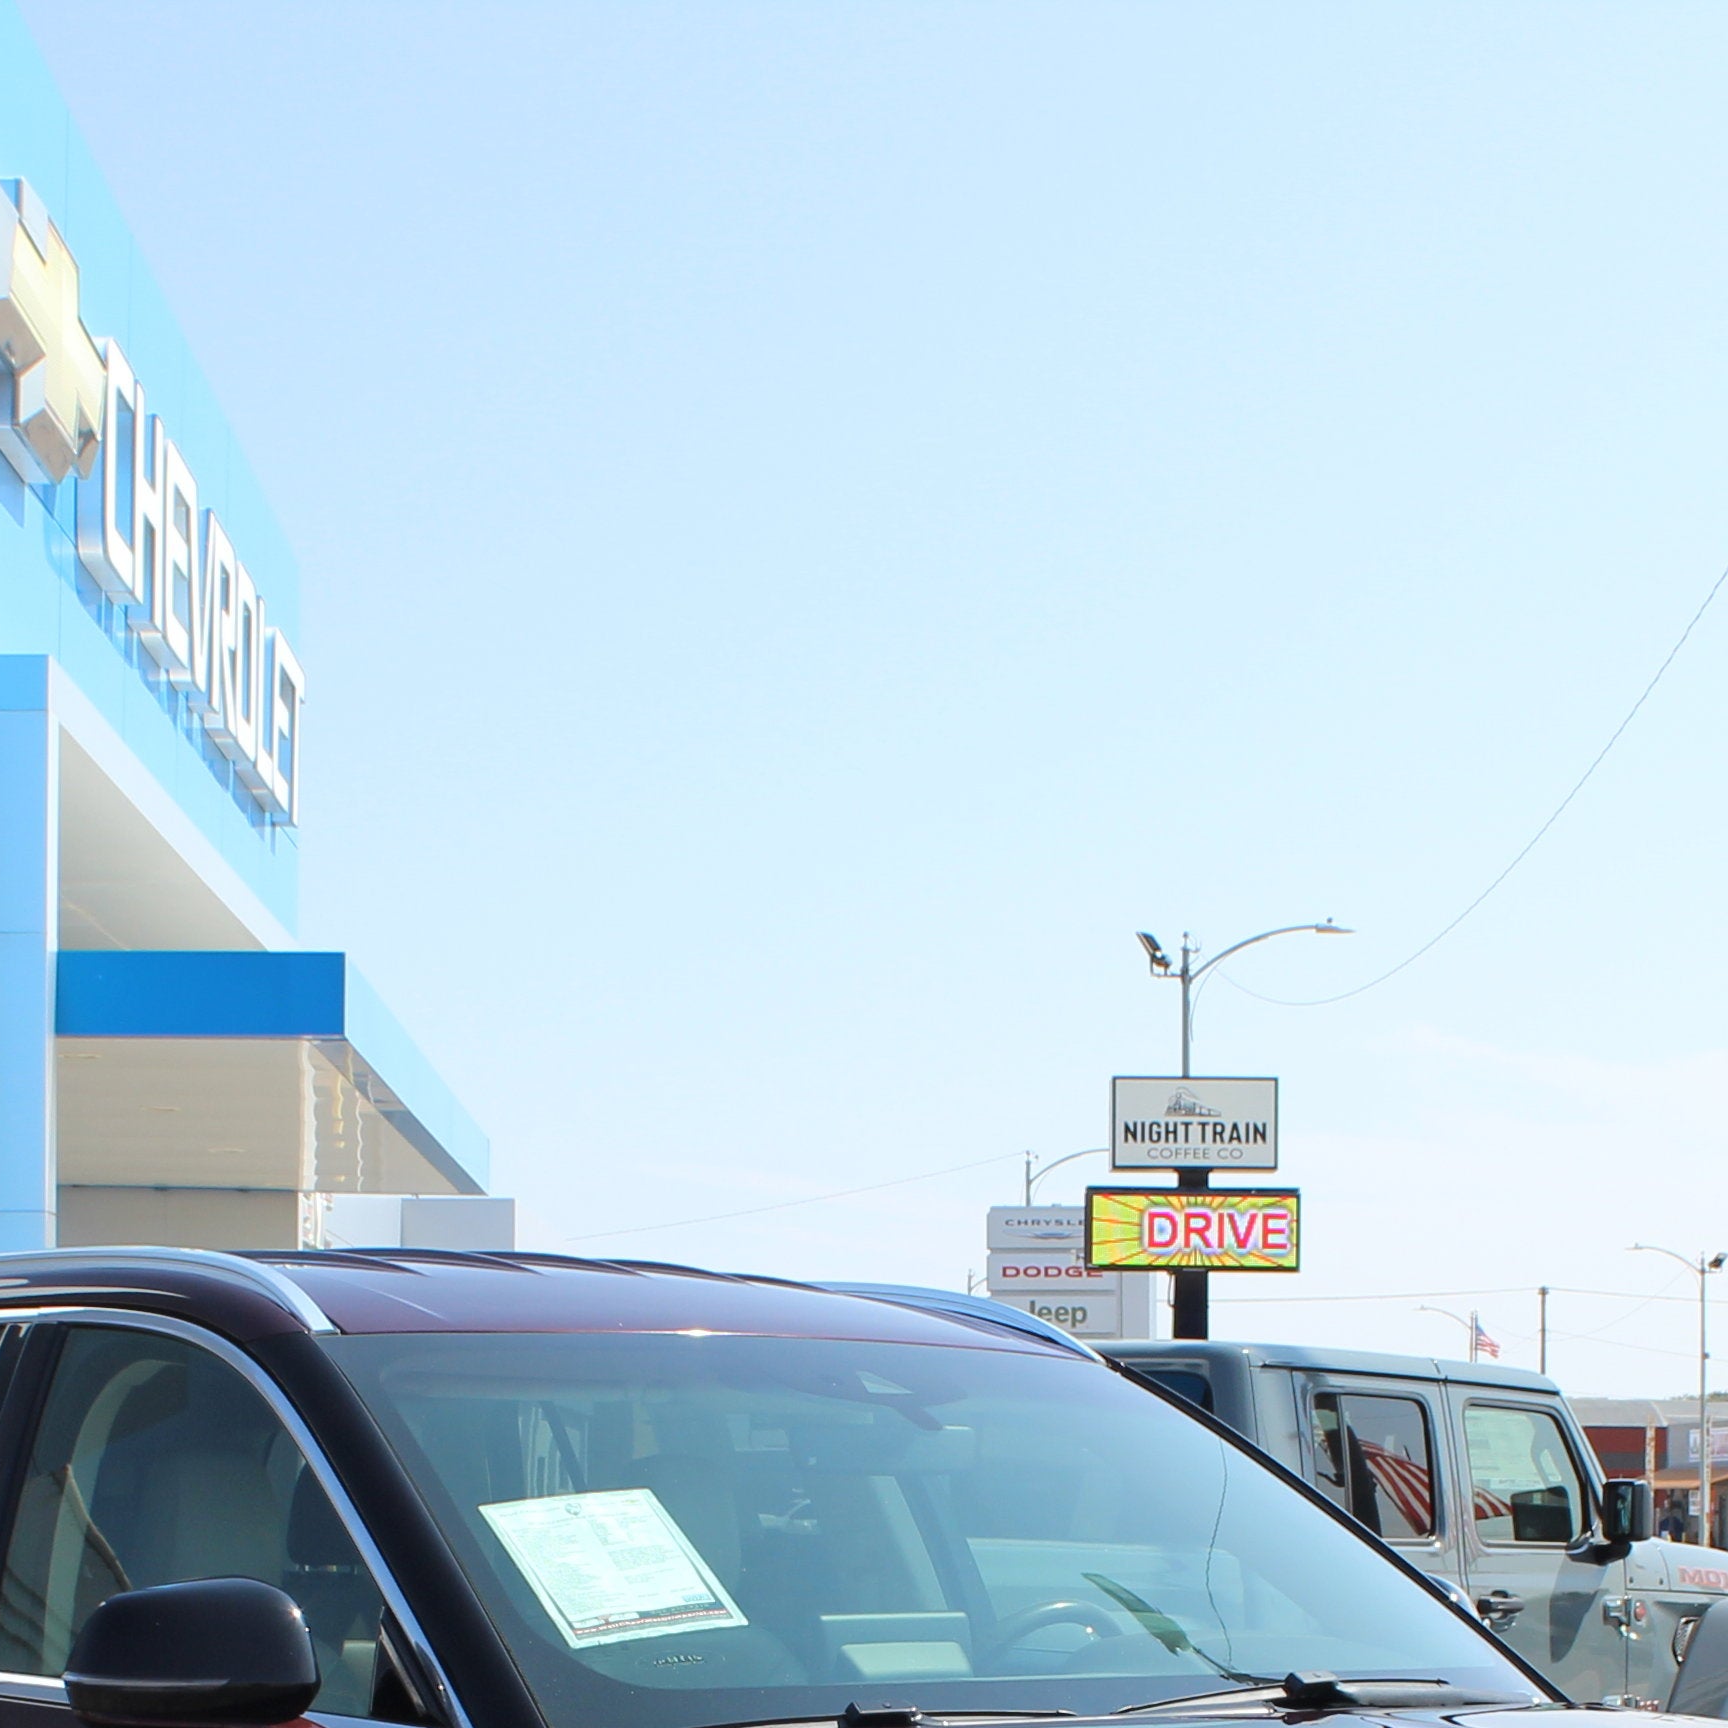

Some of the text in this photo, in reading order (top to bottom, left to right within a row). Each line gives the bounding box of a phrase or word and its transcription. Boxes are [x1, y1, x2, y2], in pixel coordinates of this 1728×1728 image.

[87, 337, 306, 829] CHEVROLET
[1124, 1121, 1268, 1145] NIGHT TRAIN
[1147, 1147, 1244, 1160] COFFEE CO
[1147, 1211, 1289, 1250] DRIVE
